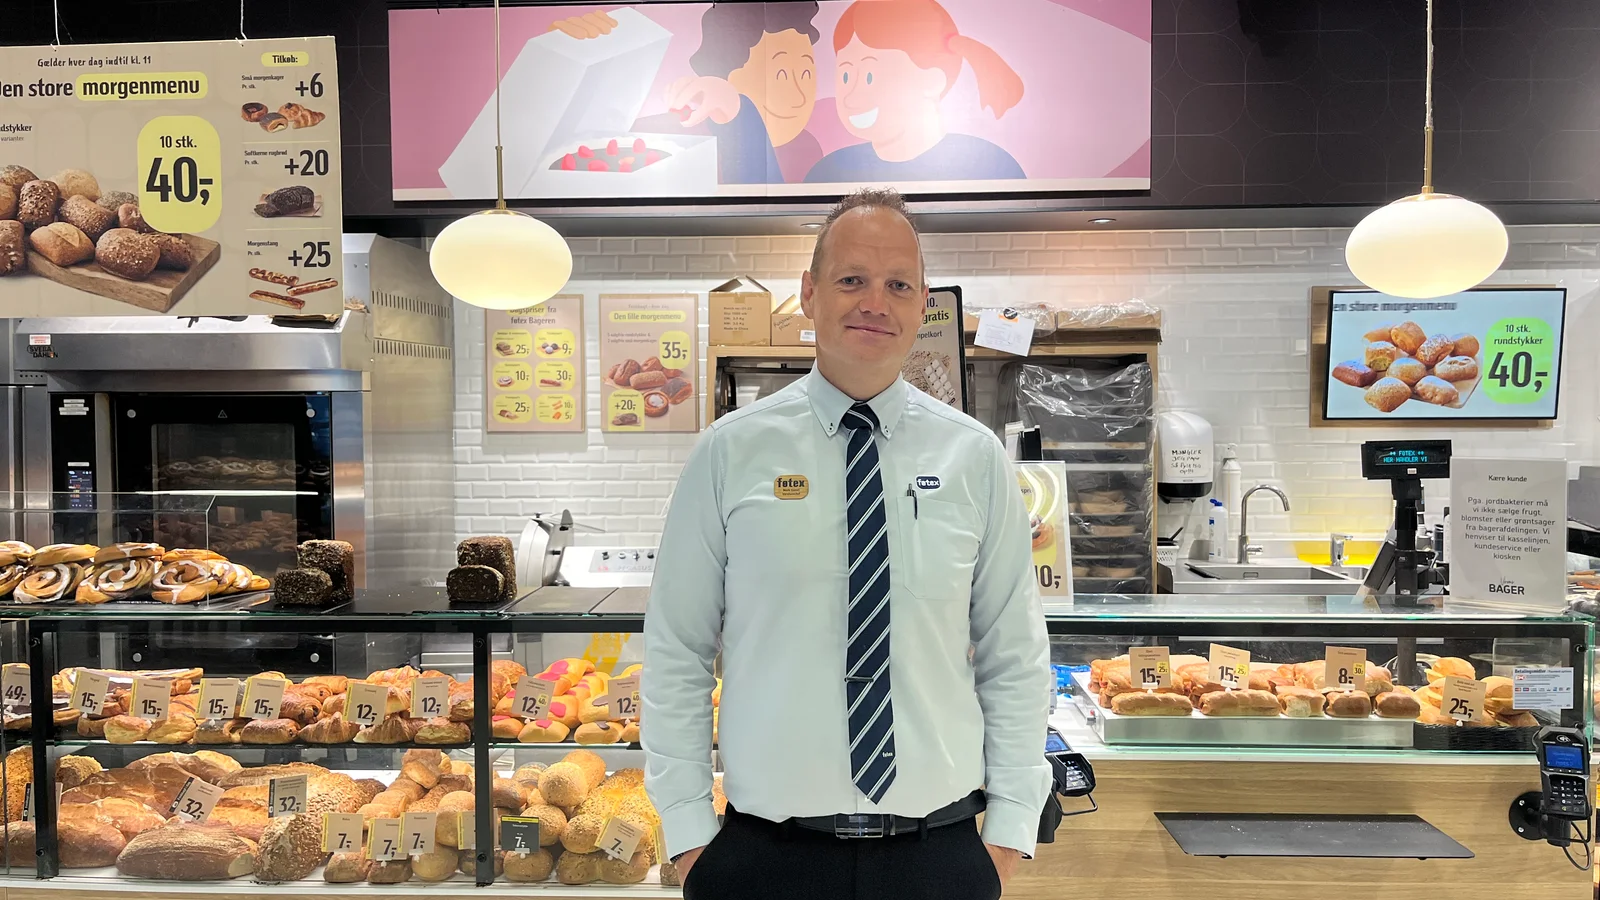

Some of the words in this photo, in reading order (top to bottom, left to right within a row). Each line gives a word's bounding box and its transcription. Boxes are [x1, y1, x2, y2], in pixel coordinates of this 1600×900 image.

[37, 58, 66, 67] Gælder
[68, 58, 86, 67] hver
[88, 57, 103, 68] dag
[105, 56, 129, 66] indtil
[131, 56, 141, 65] kl.
[143, 56, 152, 64] 11
[272, 55, 299, 64] Tilkøb:
[0, 81, 24, 97] en
[28, 77, 74, 97] store
[83, 80, 200, 99] morgenmenu
[295, 73, 324, 98] +6
[160, 135, 172, 148] 10
[175, 135, 197, 148] stk.
[284, 149, 329, 176] +20
[288, 241, 331, 268] +25
[613, 312, 626, 320] Den
[627, 312, 639, 320] lille
[640, 313, 681, 321] morgenmenu
[1505, 324, 1514, 333] 10
[1515, 324, 1531, 333] stk.
[1493, 337, 1543, 345] rundstykker
[776, 477, 805, 488] føtex
[917, 478, 939, 486] føtex
[1485, 498, 1533, 506] jordbakterier
[1514, 518, 1555, 526] grøntsager
[1465, 523, 1476, 531] fra
[1542, 527, 1550, 535] Vi
[1465, 533, 1496, 541] henviser
[1474, 542, 1521, 551] kundeservice
[1488, 583, 1525, 595] BAGER
